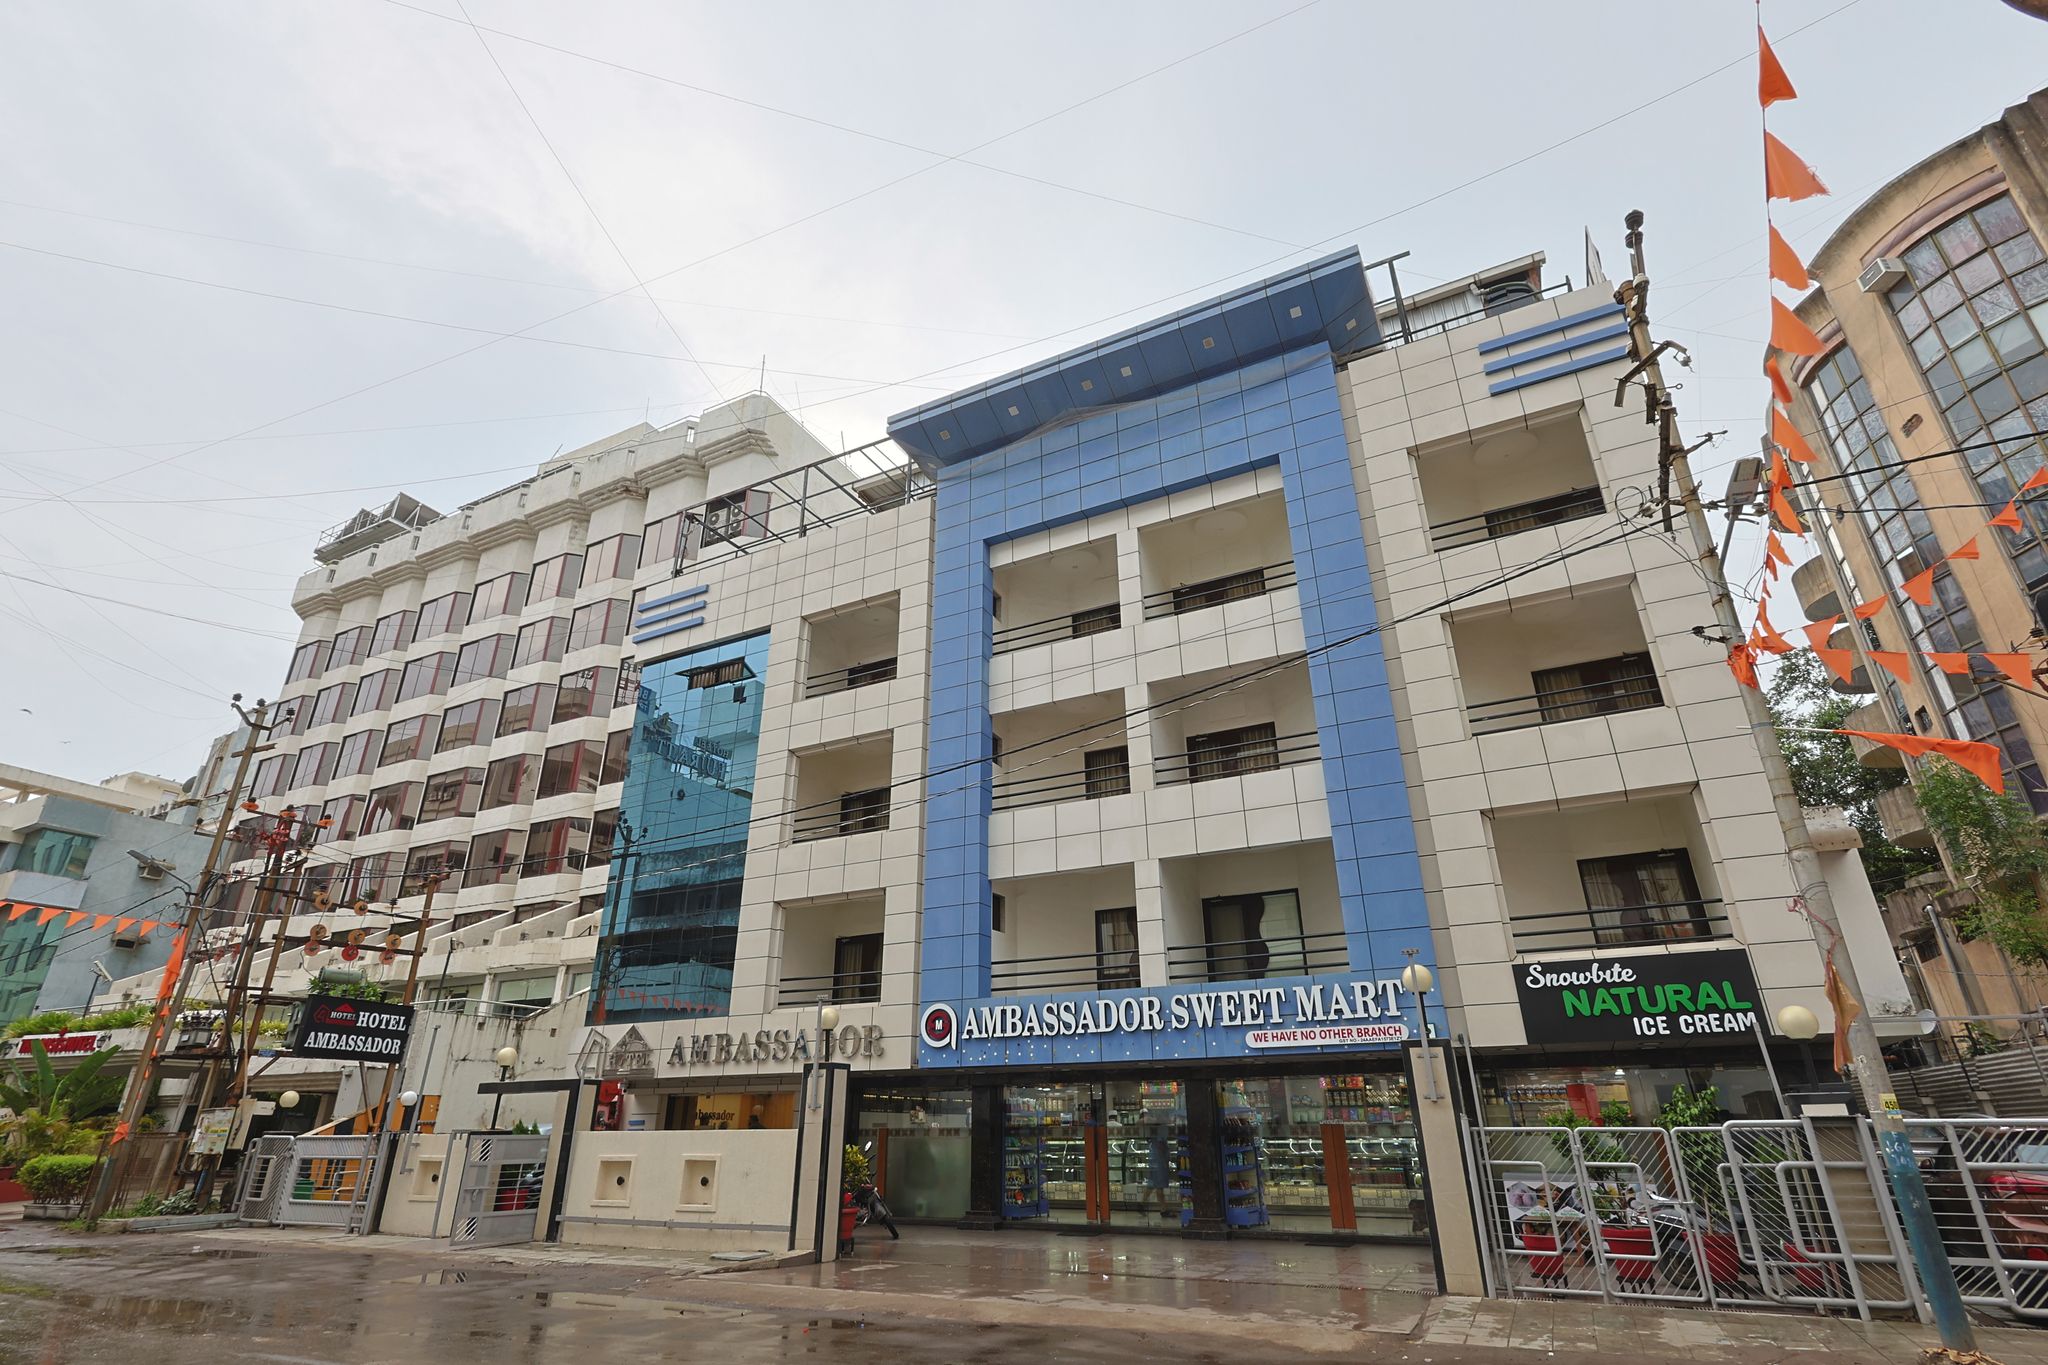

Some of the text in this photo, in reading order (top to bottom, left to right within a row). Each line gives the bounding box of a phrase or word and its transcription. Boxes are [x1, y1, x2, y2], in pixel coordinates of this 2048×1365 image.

[1525, 962, 1637, 989] Snowbite
[961, 979, 1404, 1040] AMBASSADOR SWEET MART
[1562, 980, 1753, 1018] NATURAL
[330, 1011, 356, 1021] HOTEL
[356, 1011, 407, 1031] HOTEL
[1633, 1011, 1758, 1036] ICE CREAM
[304, 1031, 401, 1055] AMBASSADOR
[1252, 1026, 1402, 1043] WE HAVE NO OTHER BRANCH
